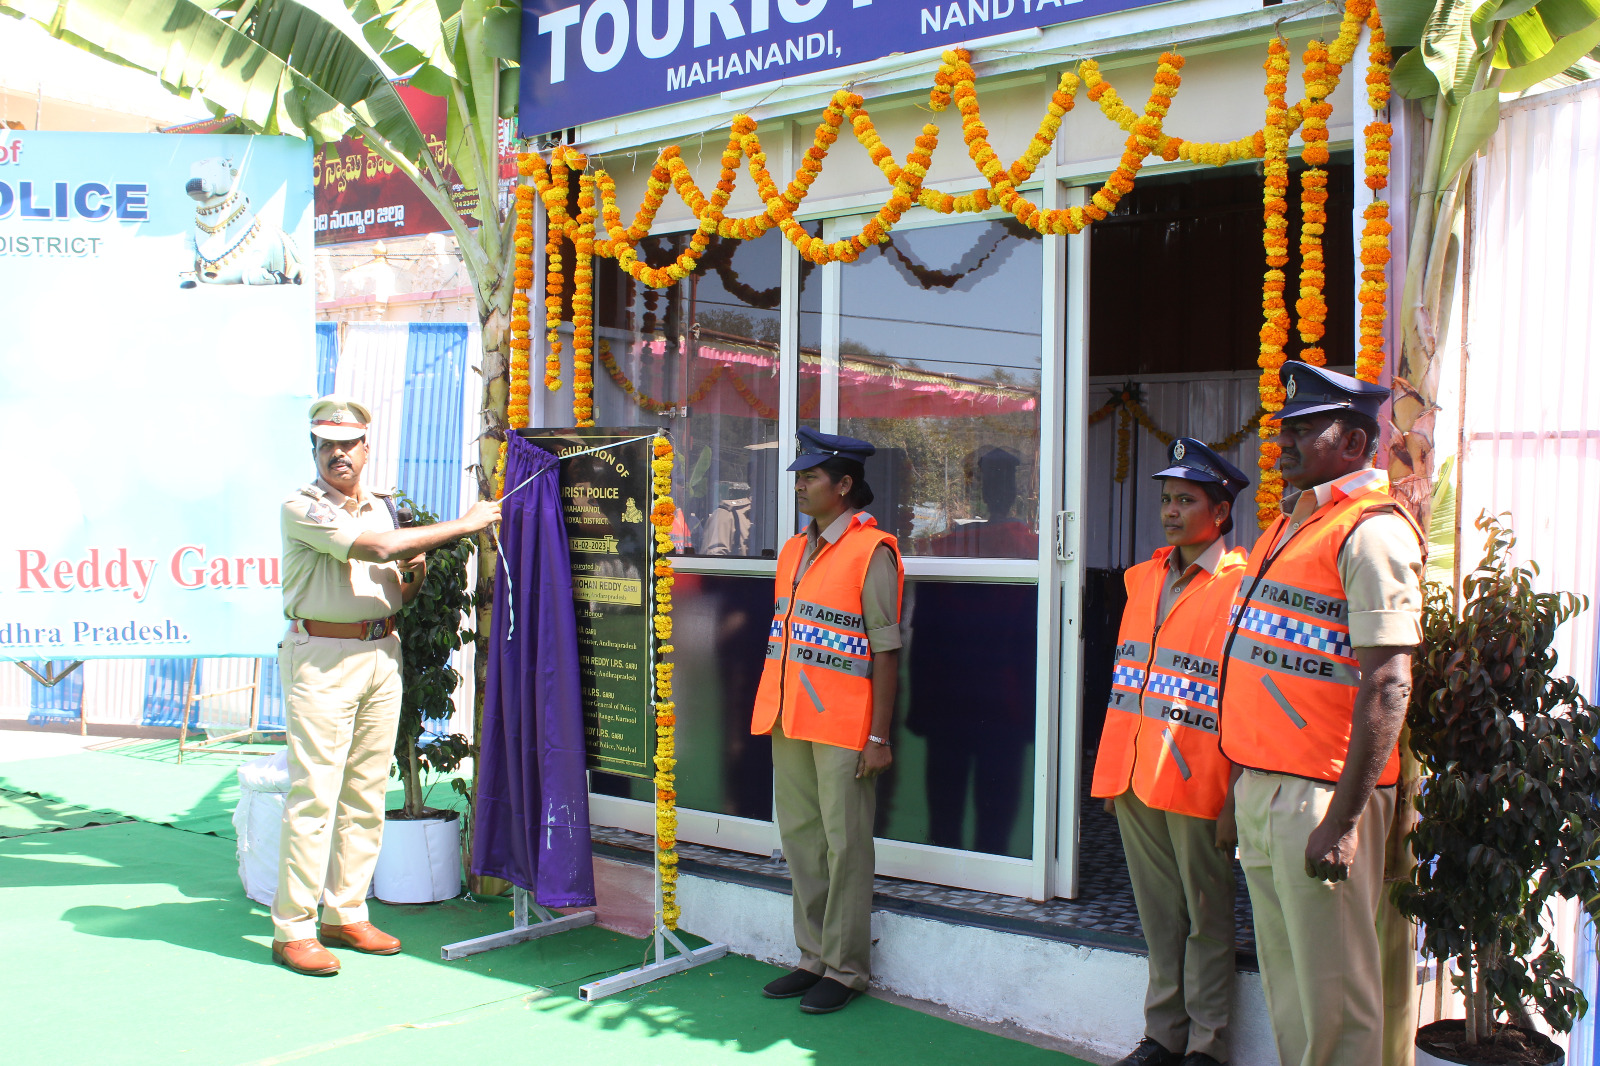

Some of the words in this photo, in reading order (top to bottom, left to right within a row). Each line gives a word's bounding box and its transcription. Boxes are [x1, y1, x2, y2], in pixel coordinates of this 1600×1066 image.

[666, 29, 842, 92] MAHANANDI,
[616, 463, 630, 478] OF
[587, 487, 619, 499] POLICE
[571, 541, 607, 550] 14-02-2023
[16, 548, 155, 600] Reddy
[170, 546, 280, 588] Garu
[599, 581, 622, 592] REDDY
[623, 585, 638, 593] GARU
[1260, 583, 1343, 619] PRADESH
[73, 620, 189, 643] Pradesh.
[590, 656, 610, 667] REDDY
[625, 662, 638, 670] GARU
[1250, 645, 1335, 678] POLICE
[1161, 705, 1219, 732] POLIC
